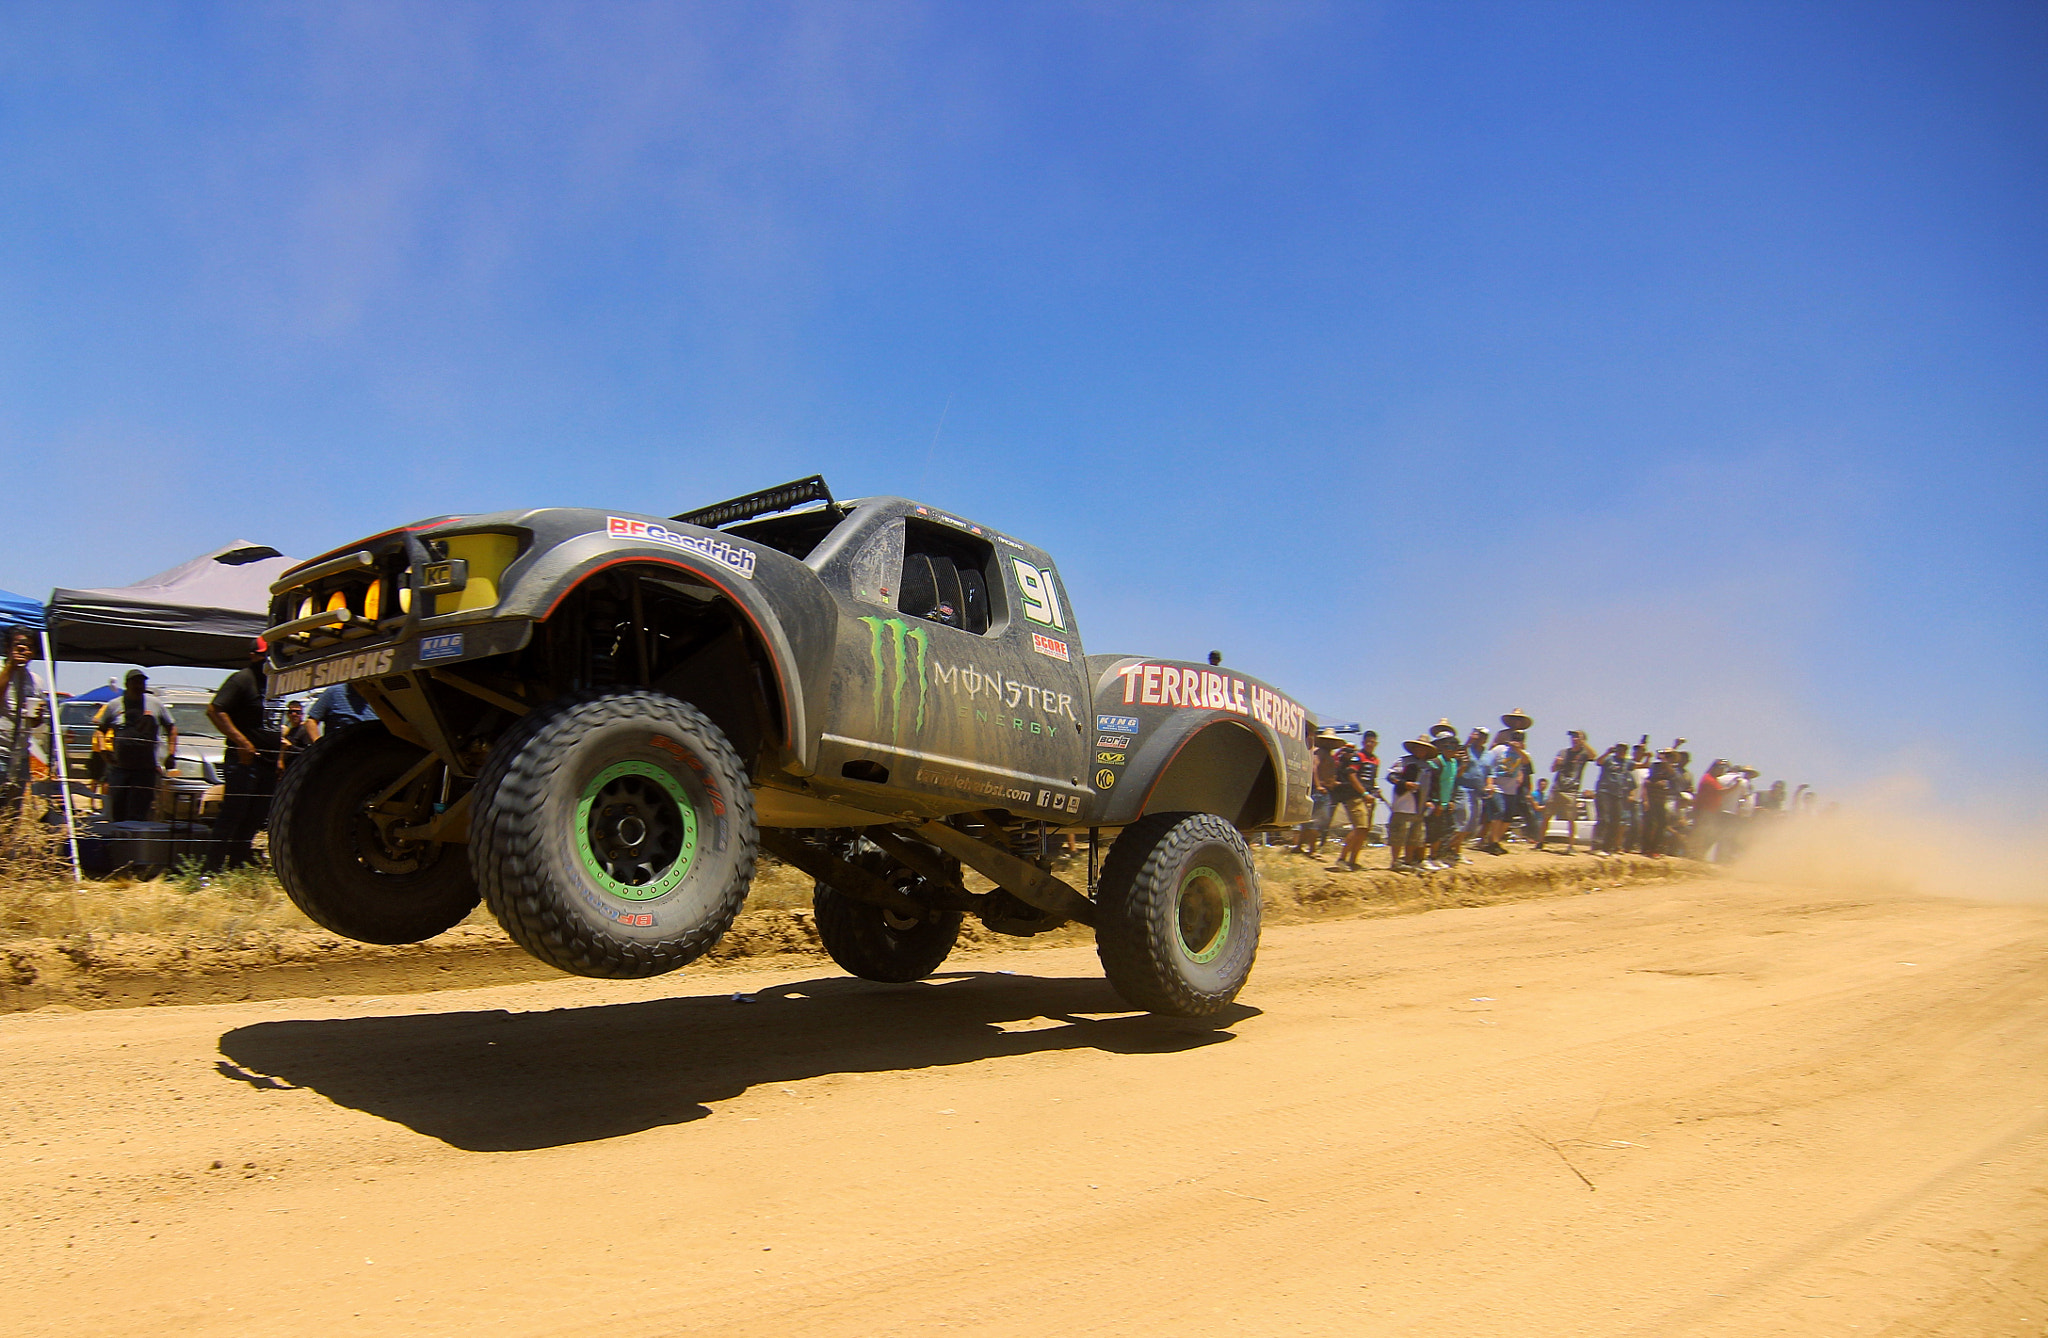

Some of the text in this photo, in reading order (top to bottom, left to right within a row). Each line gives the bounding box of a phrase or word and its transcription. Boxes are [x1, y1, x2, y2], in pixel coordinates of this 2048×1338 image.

[609, 518, 754, 571] BFGoodrich
[426, 565, 449, 586] KC
[1010, 556, 1066, 632] 91
[423, 634, 461, 650] KING
[1034, 635, 1067, 655] SCORE
[275, 649, 395, 696] KING SHOCKS
[1118, 664, 1305, 741] TERRIBLE HERBST
[959, 706, 1057, 738] ENERGY
[1099, 717, 1137, 726] KING
[650, 735, 726, 816] Baja T/A
[1098, 770, 1113, 788] KC
